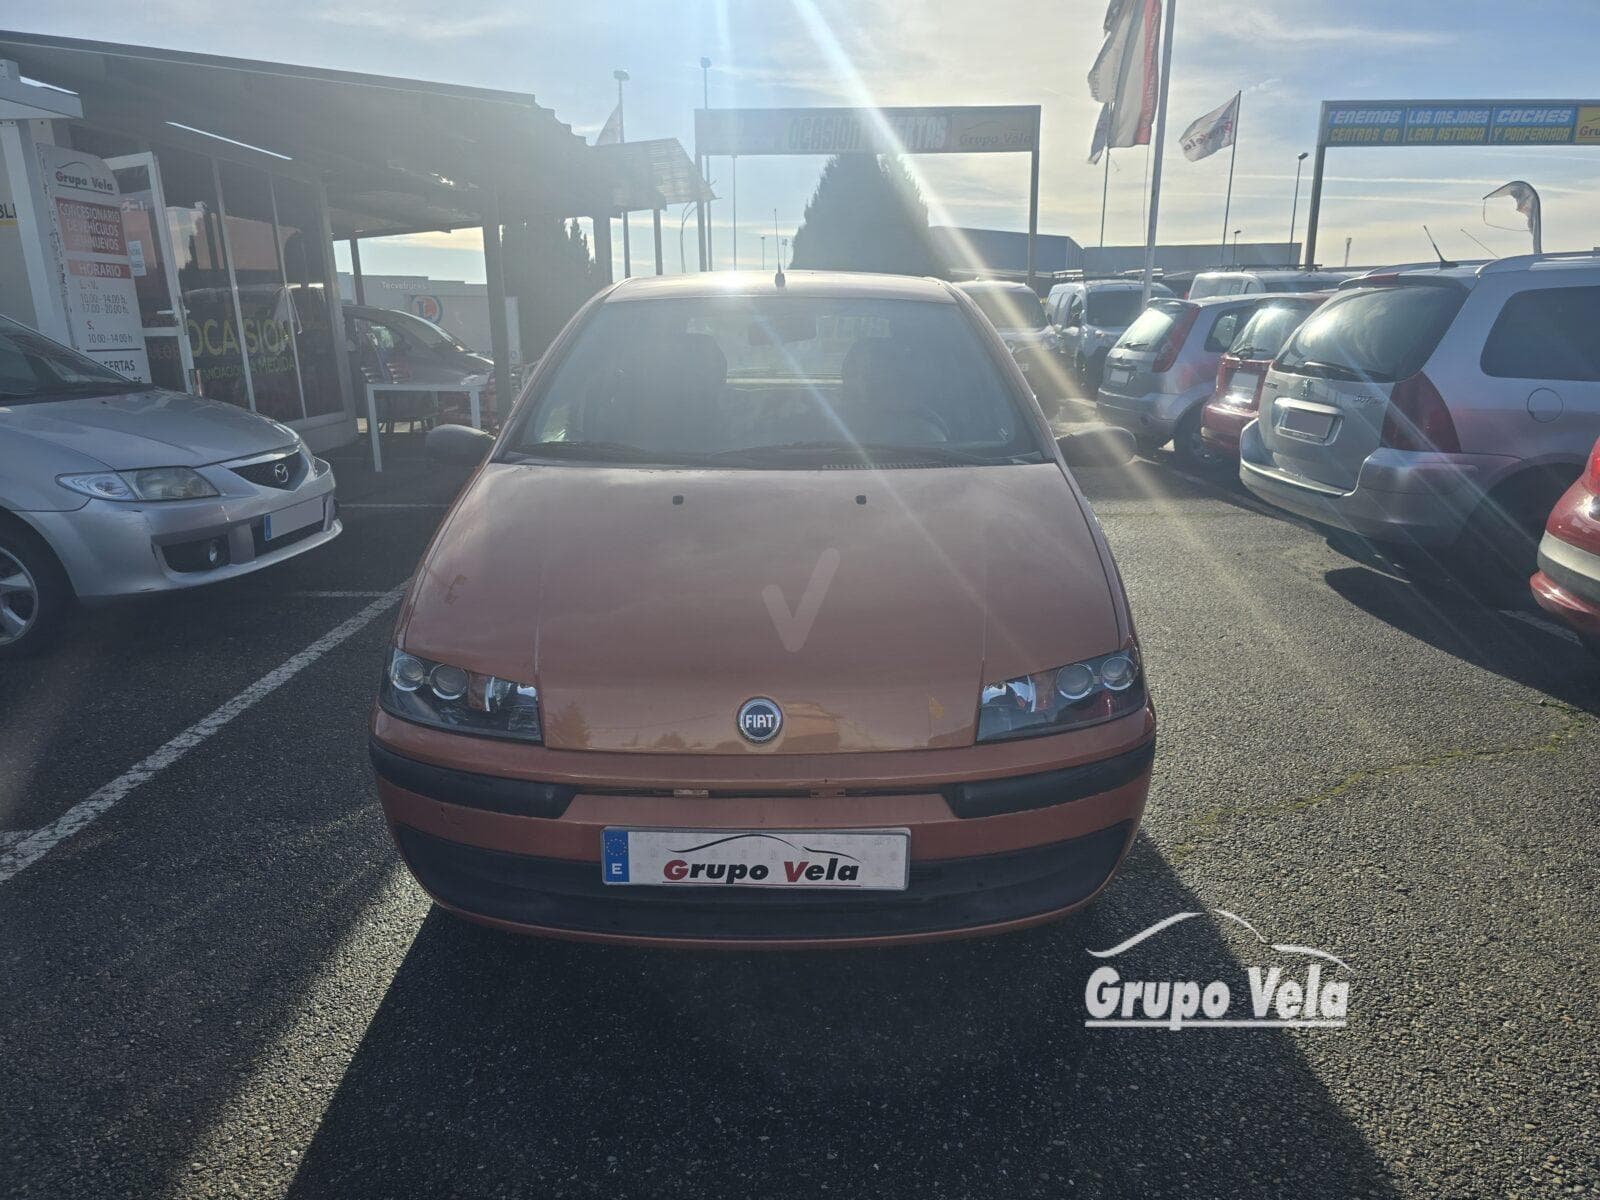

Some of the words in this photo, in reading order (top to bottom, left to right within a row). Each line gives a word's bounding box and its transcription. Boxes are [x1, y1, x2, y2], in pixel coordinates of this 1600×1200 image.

[1329, 110, 1402, 124] TENEMOS
[1408, 110, 1433, 124] LOS
[1433, 110, 1490, 124] MEJORES
[1497, 109, 1572, 123] COCHES
[55, 170, 88, 188] Grupo
[91, 177, 113, 191] Vela
[79, 263, 121, 277] HORARIO
[104, 360, 136, 372] ERTAS
[744, 714, 775, 729] FIAT
[611, 862, 622, 874] E
[663, 859, 769, 884] Grupo
[784, 858, 859, 882] Vela
